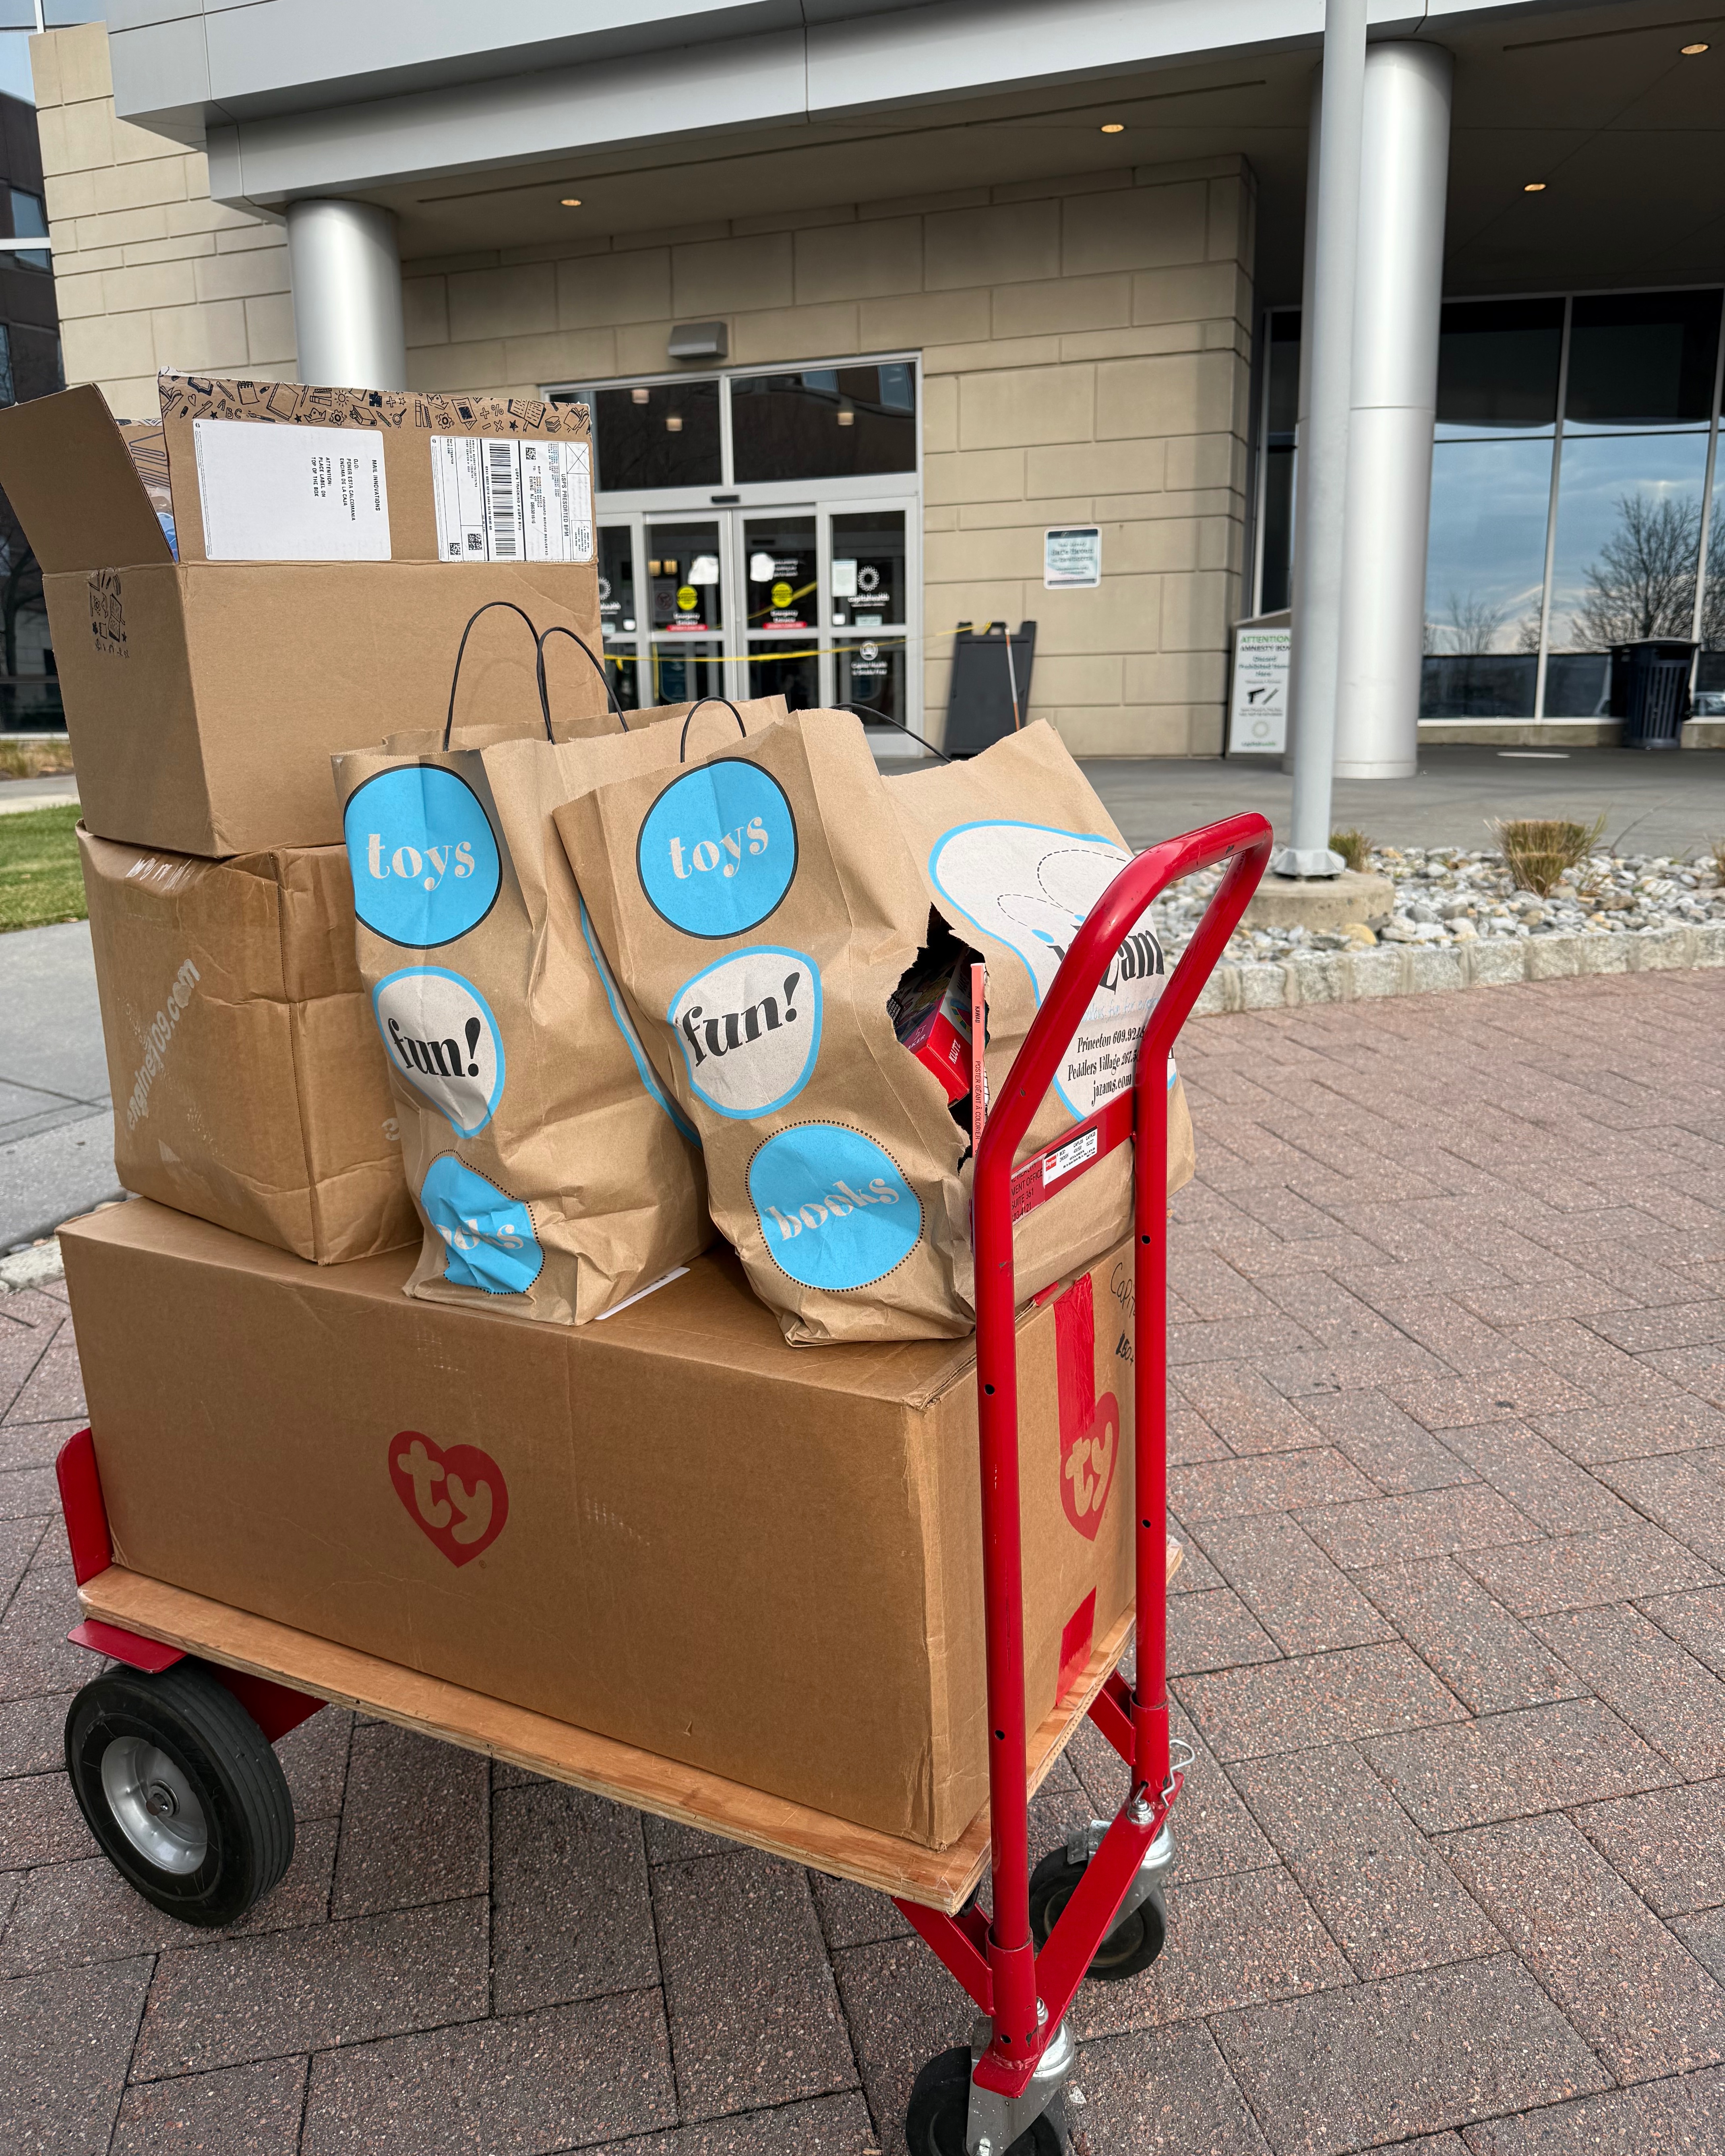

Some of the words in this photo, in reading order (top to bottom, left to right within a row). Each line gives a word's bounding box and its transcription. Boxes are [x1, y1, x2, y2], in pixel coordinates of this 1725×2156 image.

[365, 833, 475, 892] toys
[668, 816, 769, 880] toys
[387, 1017, 481, 1078] fun!
[682, 972, 801, 1068] fun!
[907, 1034, 926, 1050] AKER
[1077, 1031, 1111, 1053] Princeton
[948, 1038, 961, 1065] KLUTZ
[1067, 1059, 1097, 1082] Peddlers
[1099, 1053, 1120, 1075] Village
[1091, 1073, 1132, 1106] jazams.com
[1026, 1168, 1043, 1186] OFFICE
[765, 1178, 900, 1241] books
[397, 1439, 494, 1545] ty
[1065, 1420, 1113, 1518] ty
